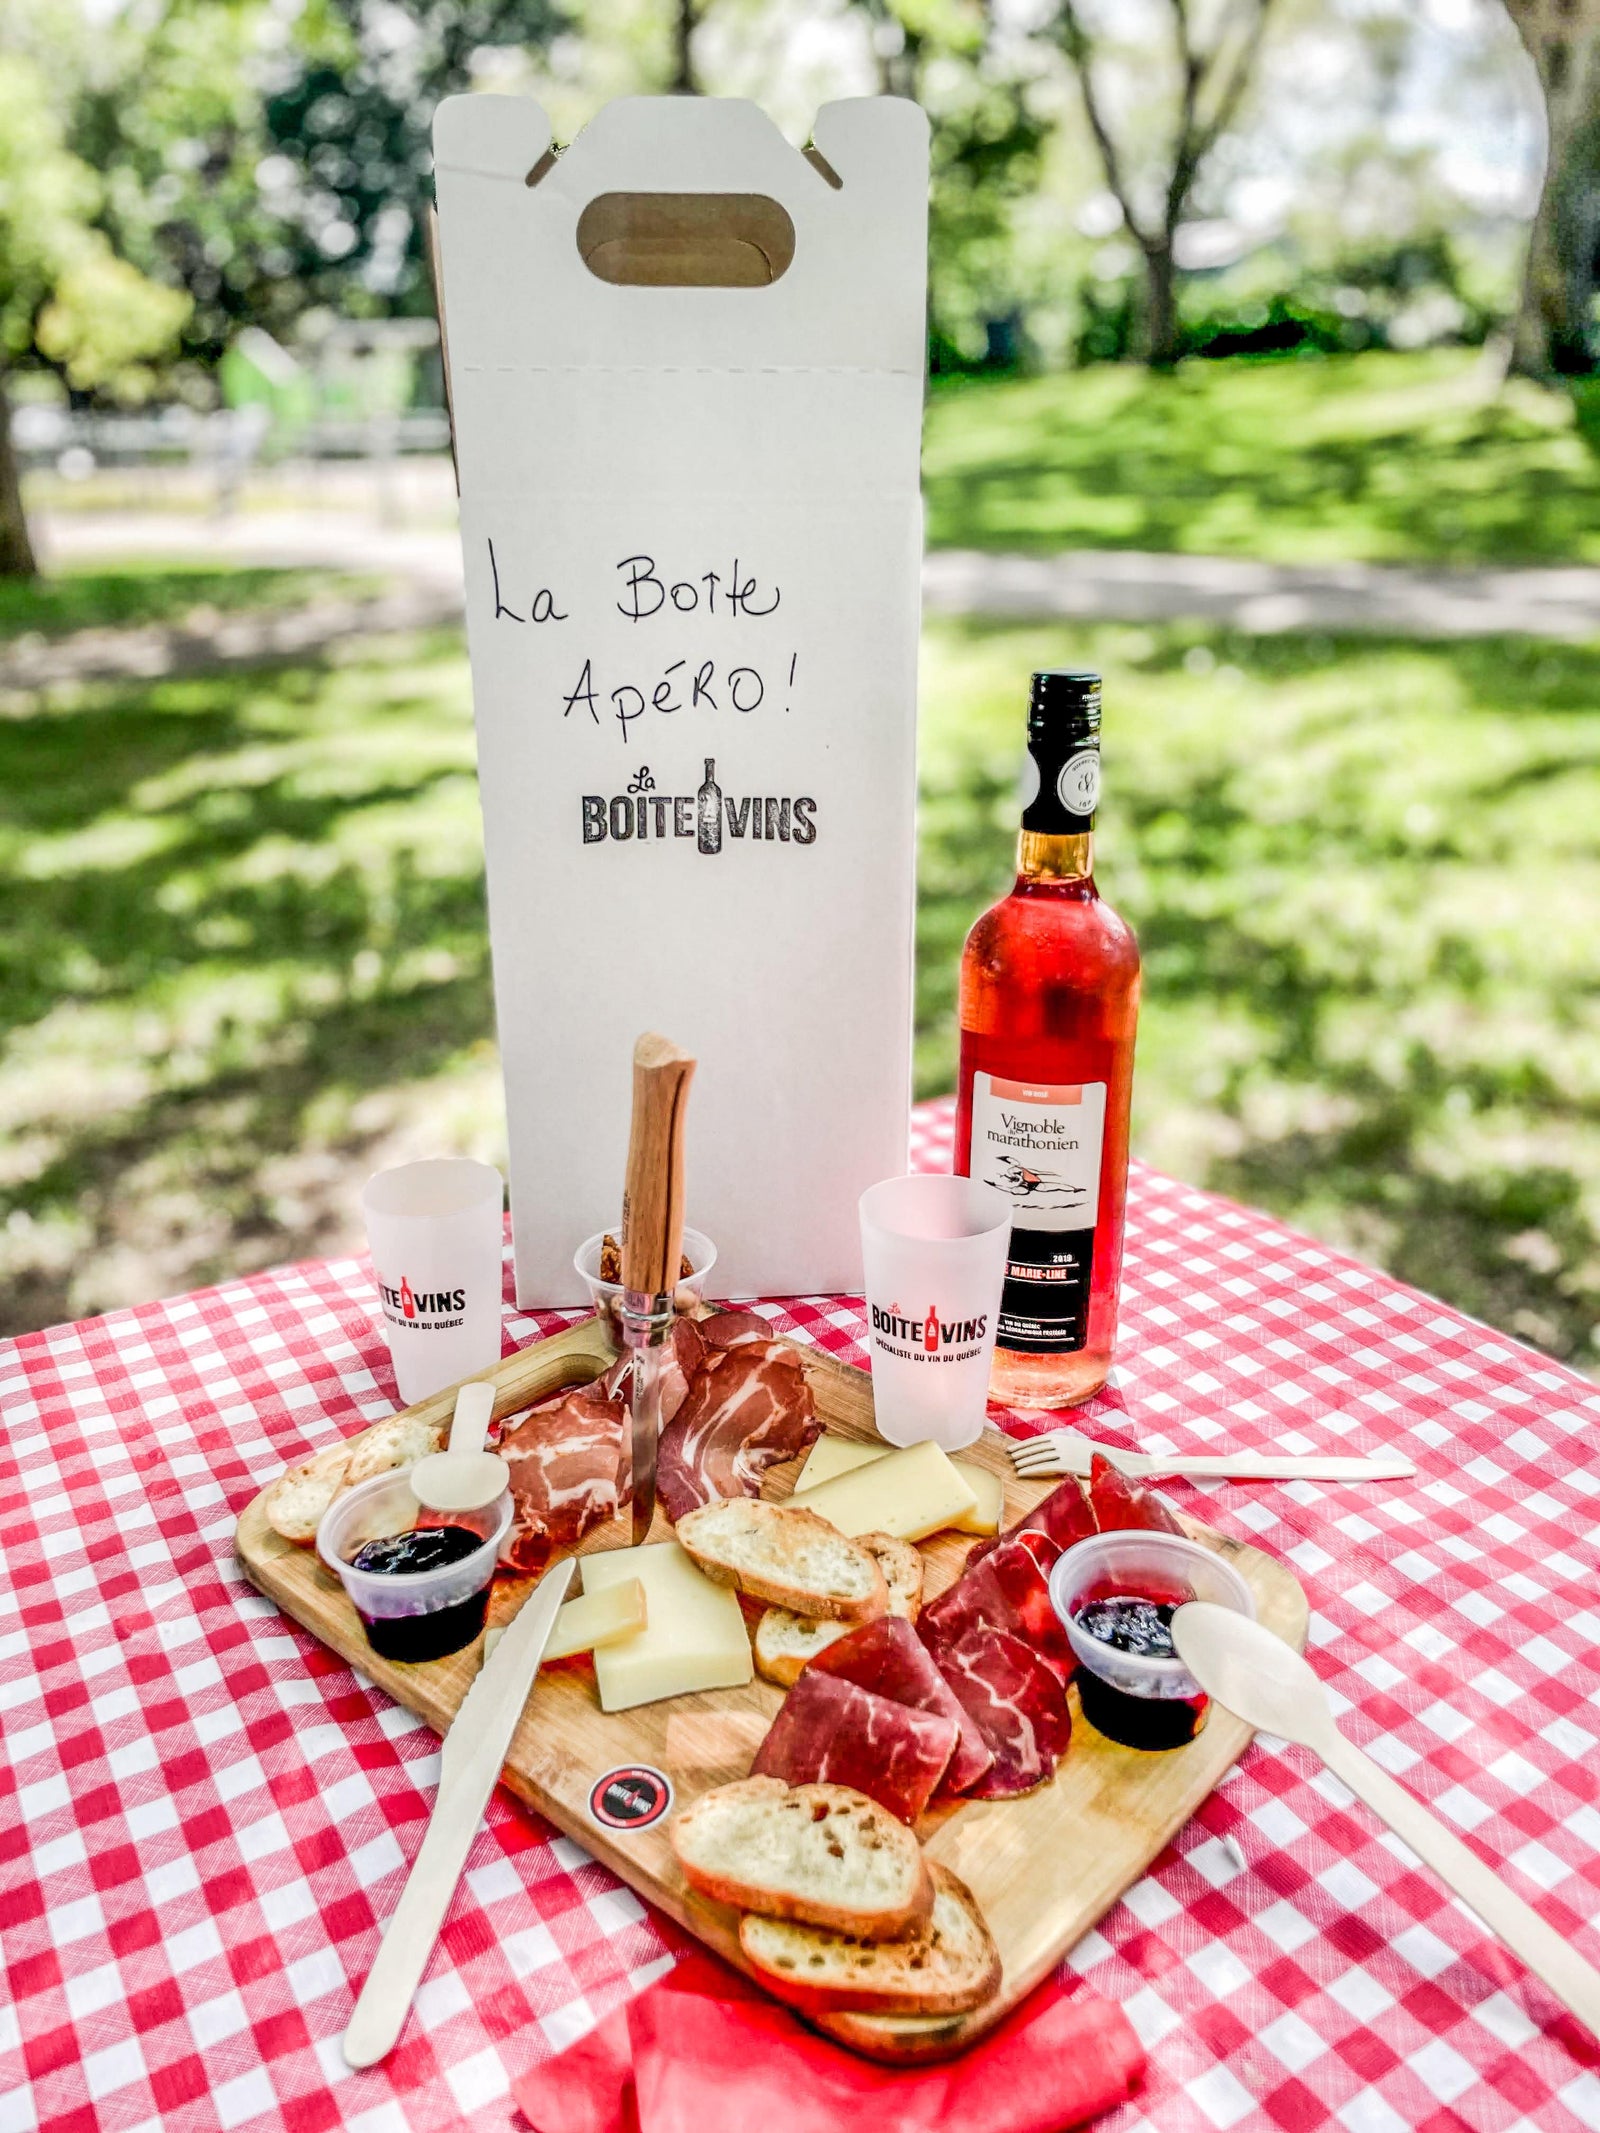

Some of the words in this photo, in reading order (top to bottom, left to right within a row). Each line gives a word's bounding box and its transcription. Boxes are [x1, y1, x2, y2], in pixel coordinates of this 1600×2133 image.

[488, 538, 568, 623] La
[617, 555, 780, 623] Boîte
[627, 766, 656, 793] La
[724, 797, 817, 844] VINS
[1001, 1113, 1065, 1134] Vignoble
[987, 1130, 1079, 1150] marathonien
[1010, 1265, 1067, 1280] MARIE-LINE
[413, 1289, 466, 1313] VINS
[887, 1302, 901, 1314] La
[408, 1321, 419, 1329] VIN
[434, 1318, 464, 1329] QUÉBEC
[940, 1314, 987, 1343] VINS
[914, 1353, 925, 1362] DU
[943, 1354, 954, 1362] DU
[956, 1346, 982, 1362] QUÉBEC
